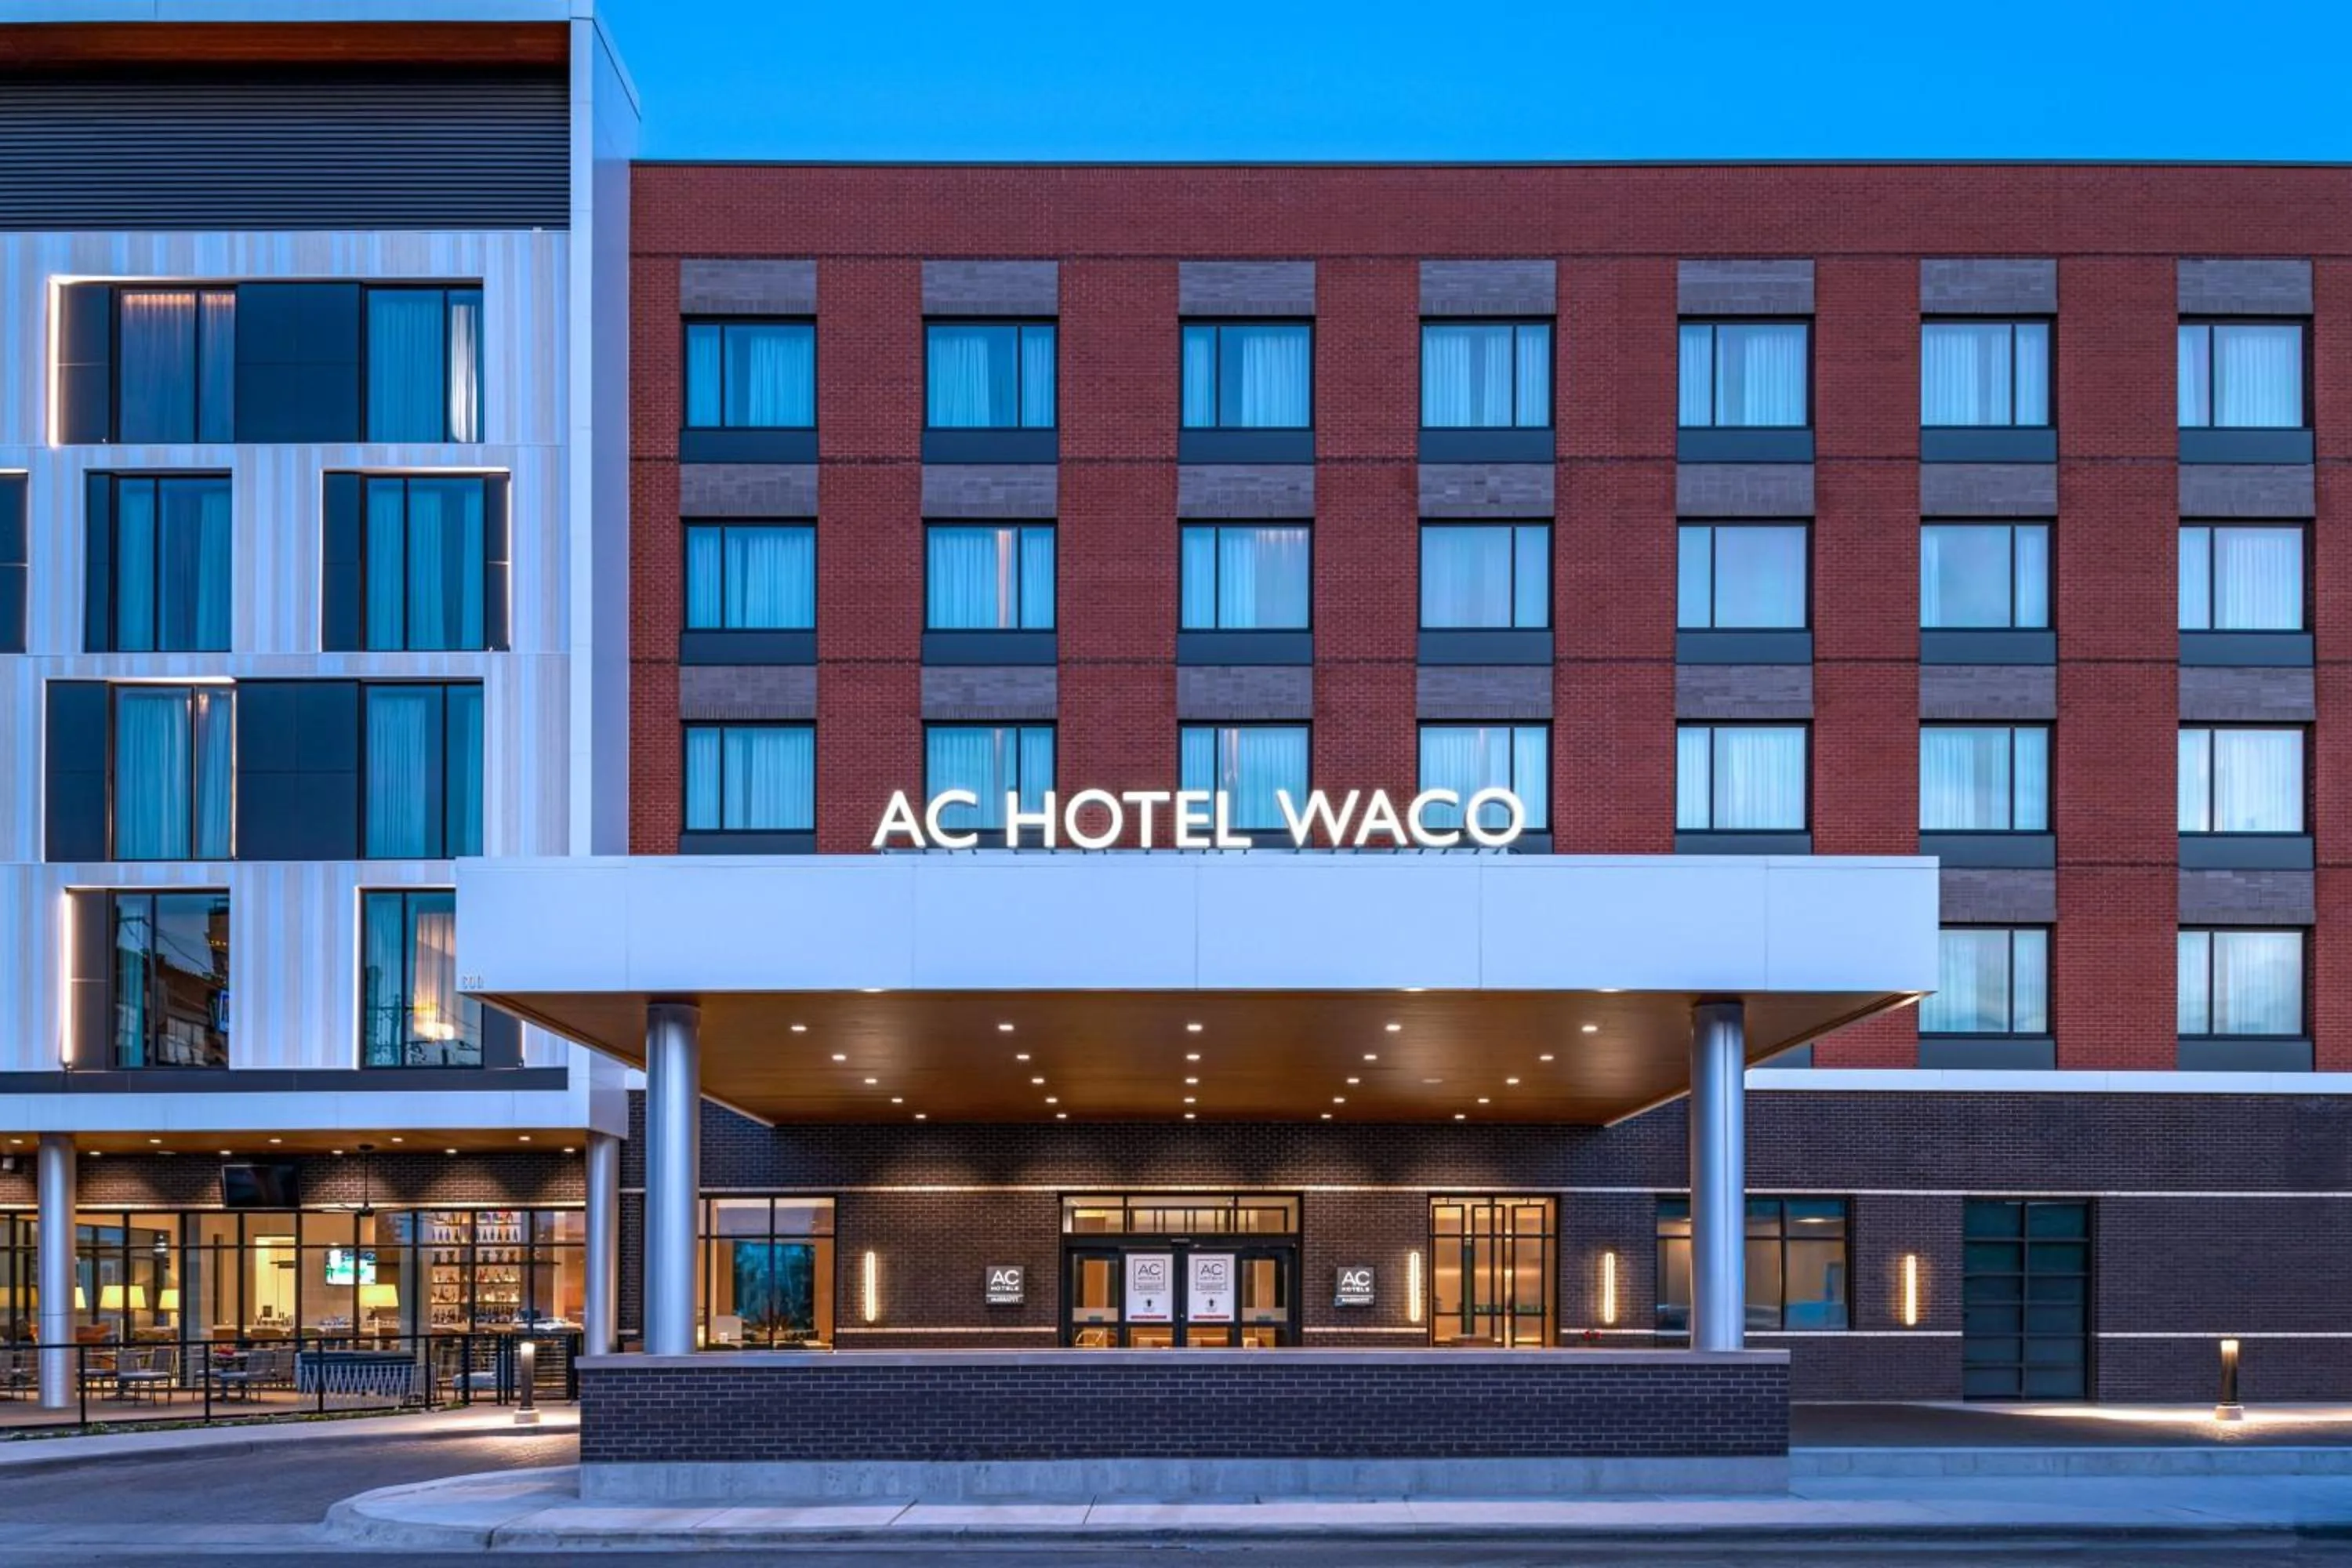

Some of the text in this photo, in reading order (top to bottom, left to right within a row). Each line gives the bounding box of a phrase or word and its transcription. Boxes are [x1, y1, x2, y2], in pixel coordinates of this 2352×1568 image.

[872, 788, 1526, 849] AC HOTEL WACO
[990, 1269, 1019, 1285] AC
[1138, 1263, 1161, 1276] AC
[1200, 1263, 1223, 1276] AC
[1341, 1270, 1370, 1286] AC
